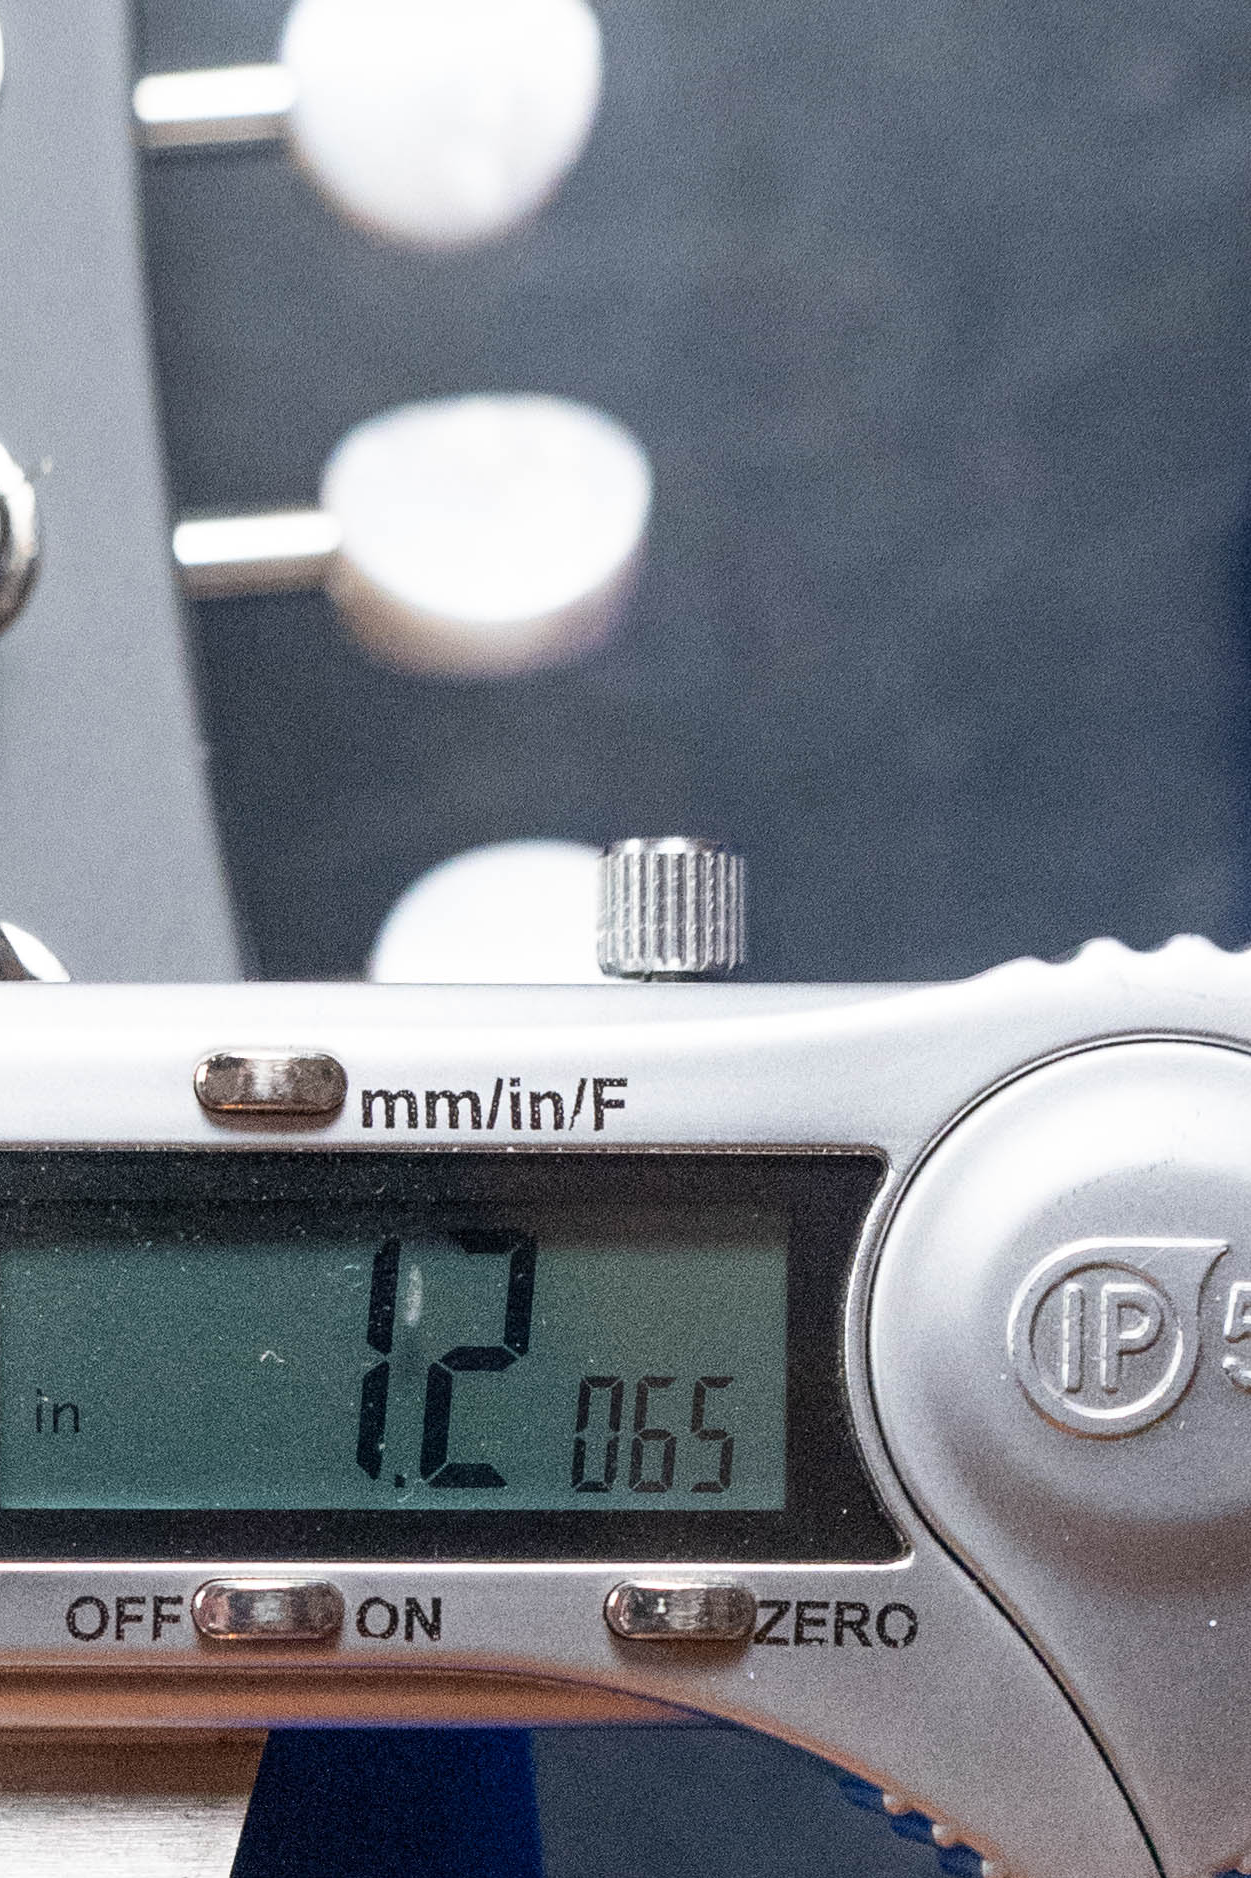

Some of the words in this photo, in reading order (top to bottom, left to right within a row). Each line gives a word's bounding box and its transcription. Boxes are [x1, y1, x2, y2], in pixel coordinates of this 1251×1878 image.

[360, 1076, 629, 1133] mm/in/F
[1061, 1281, 1165, 1395] IP
[34, 1388, 81, 1435] in
[65, 1595, 184, 1642] OFF
[356, 1595, 443, 1642] ON
[752, 1600, 919, 1648] ZERO
